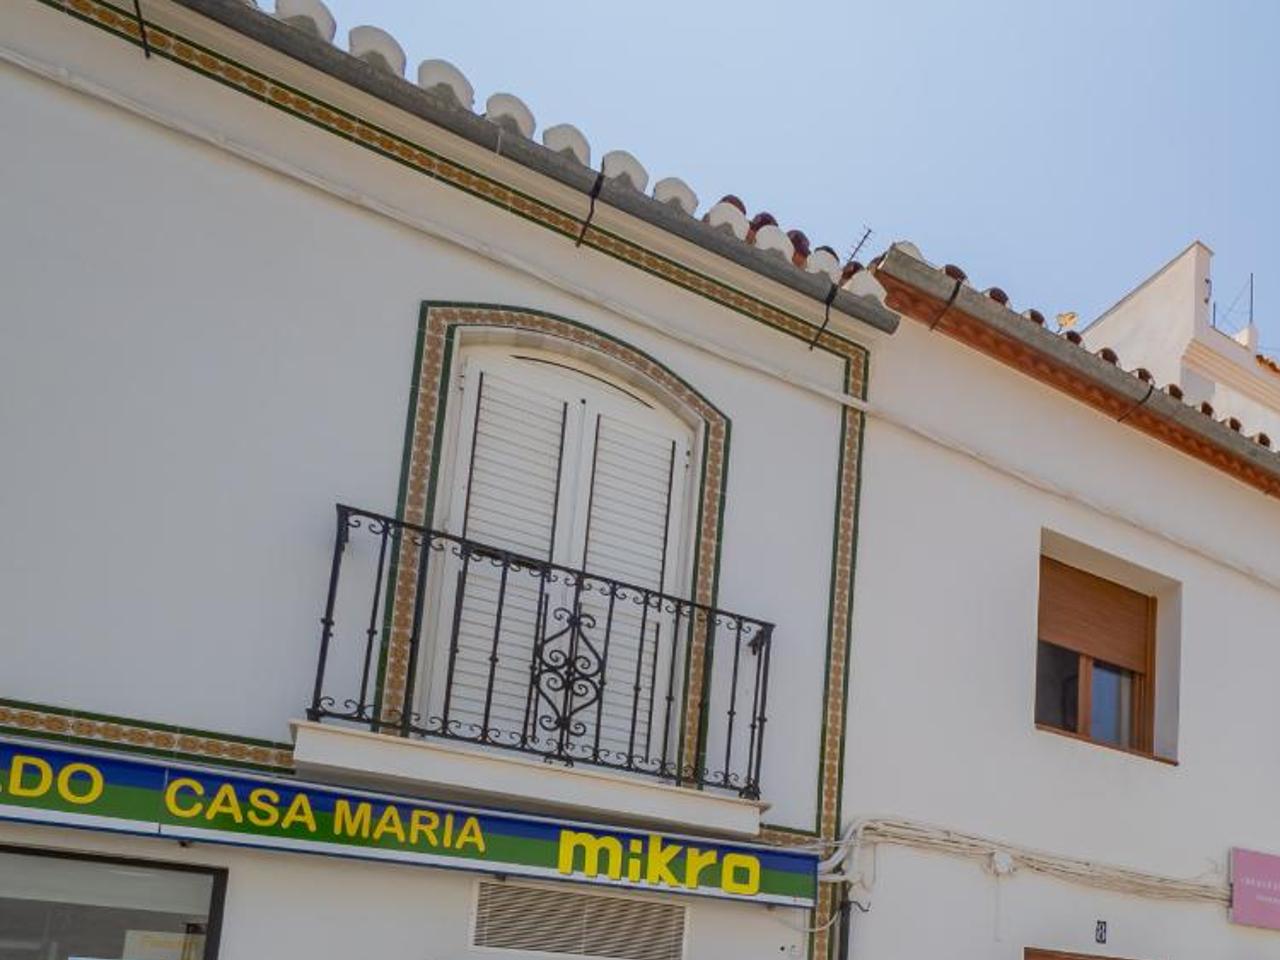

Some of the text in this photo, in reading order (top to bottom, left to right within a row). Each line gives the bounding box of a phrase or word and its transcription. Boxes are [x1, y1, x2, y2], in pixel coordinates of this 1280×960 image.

[0, 755, 486, 853] DO CASA MARIA
[558, 829, 760, 895] mikro
